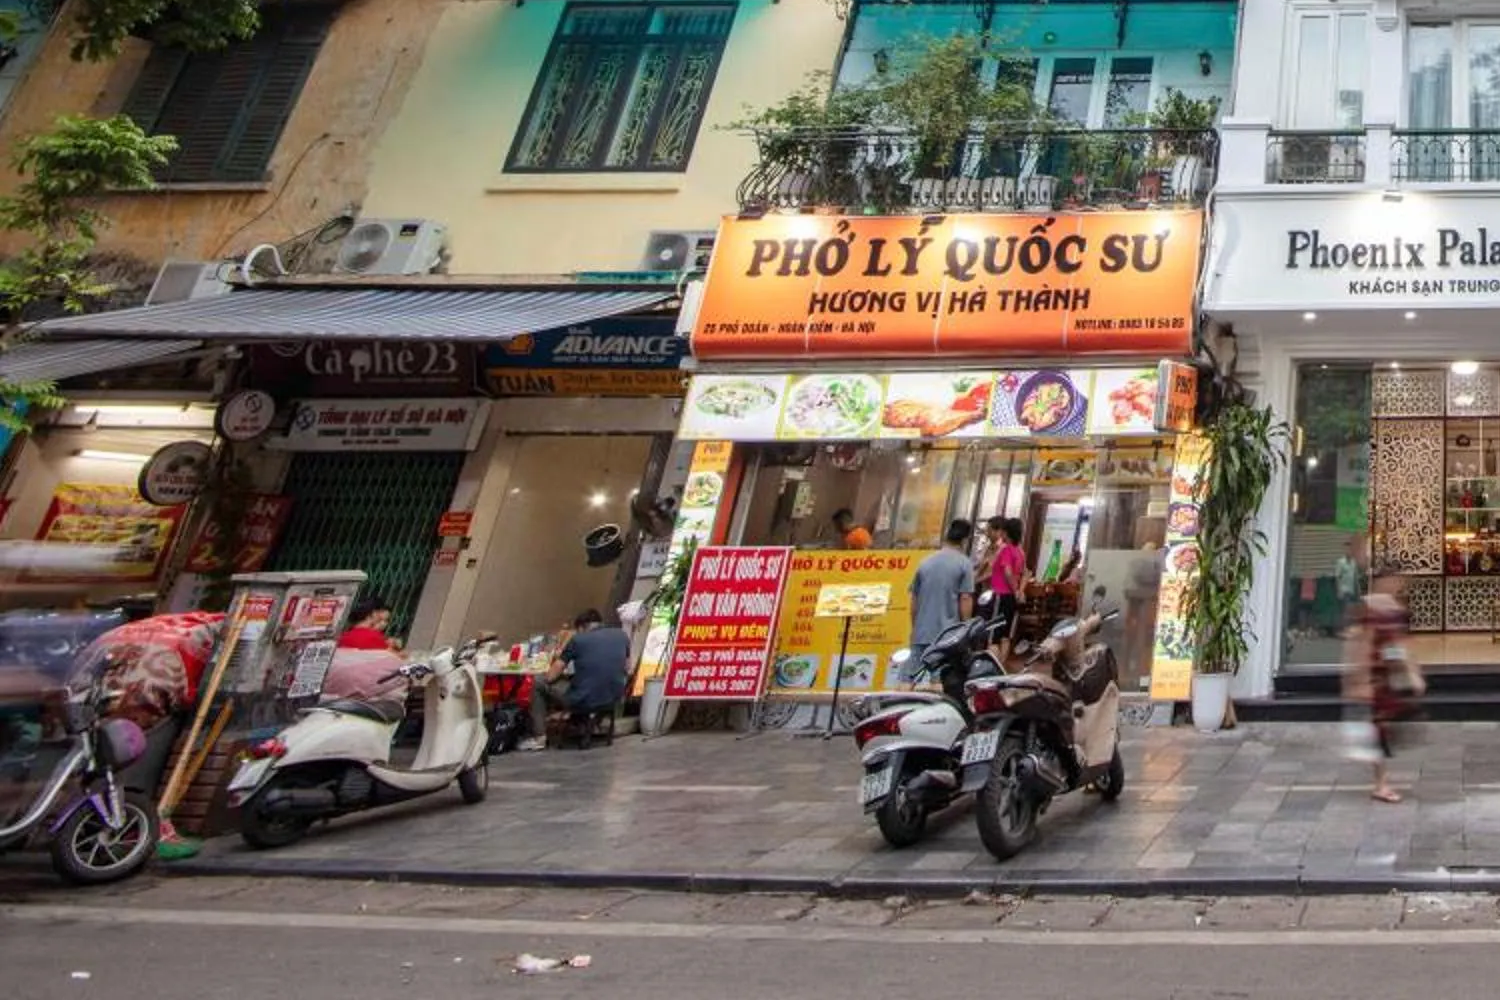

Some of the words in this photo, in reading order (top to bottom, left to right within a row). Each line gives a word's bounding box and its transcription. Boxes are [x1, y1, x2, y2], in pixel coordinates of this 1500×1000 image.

[745, 219, 856, 277] PHỞ
[862, 226, 934, 277] LÝ
[943, 217, 1088, 282] QUỐC
[1099, 229, 1171, 273] SƯ
[1285, 229, 1426, 270] Phoenix
[1348, 276, 1407, 294] KHÁCH
[1411, 280, 1444, 297] SẠN
[807, 289, 907, 315] HƯƠNG
[916, 291, 944, 319] VỊ
[948, 285, 988, 315] HÀ
[997, 283, 1091, 314] THÀNH
[421, 342, 458, 374] 23
[552, 335, 678, 355] ADVANCE
[791, 554, 813, 571] HỞ
[841, 552, 885, 572] QUỐC
[887, 555, 911, 570] SƯ
[682, 624, 718, 640] PHỤC
[720, 624, 739, 640] VỤ
